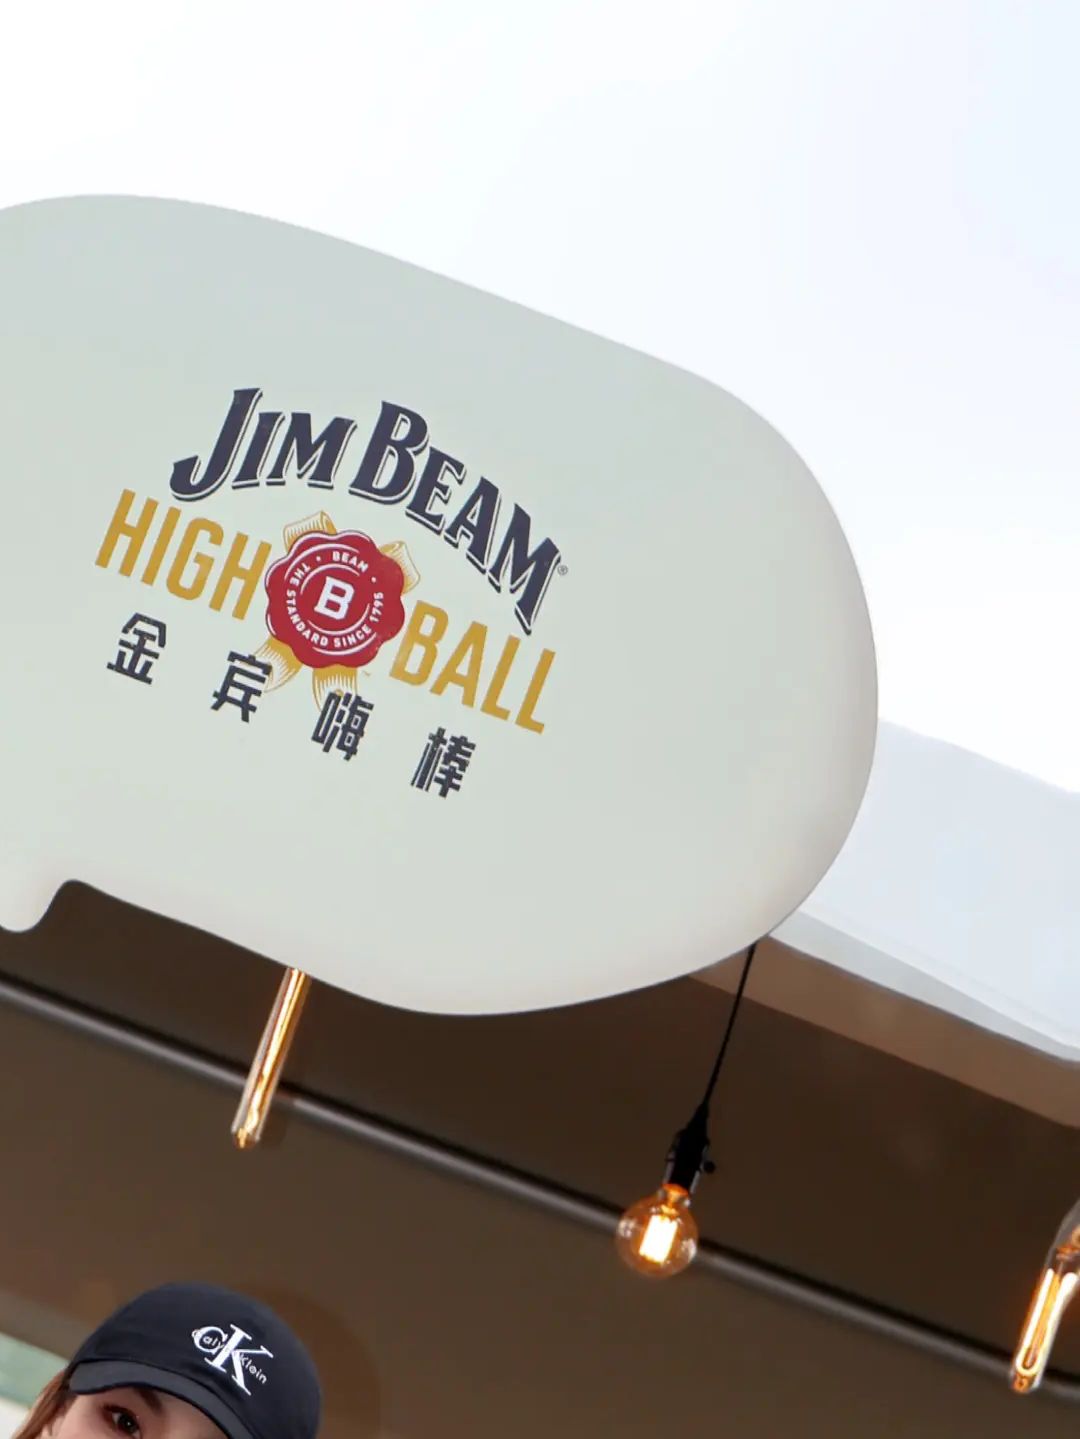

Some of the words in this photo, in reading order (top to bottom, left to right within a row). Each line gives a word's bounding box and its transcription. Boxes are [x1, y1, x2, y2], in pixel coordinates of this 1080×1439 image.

[169, 387, 357, 502] JIM
[349, 400, 561, 636] BEAM
[290, 563, 311, 587] THE
[332, 551, 369, 572] BEAM
[95, 488, 272, 620] HIGH
[389, 599, 555, 734] BALL
[314, 576, 355, 620] B
[369, 592, 385, 622] 1795
[286, 589, 329, 647] STANDARD
[334, 624, 372, 648] SINCE
